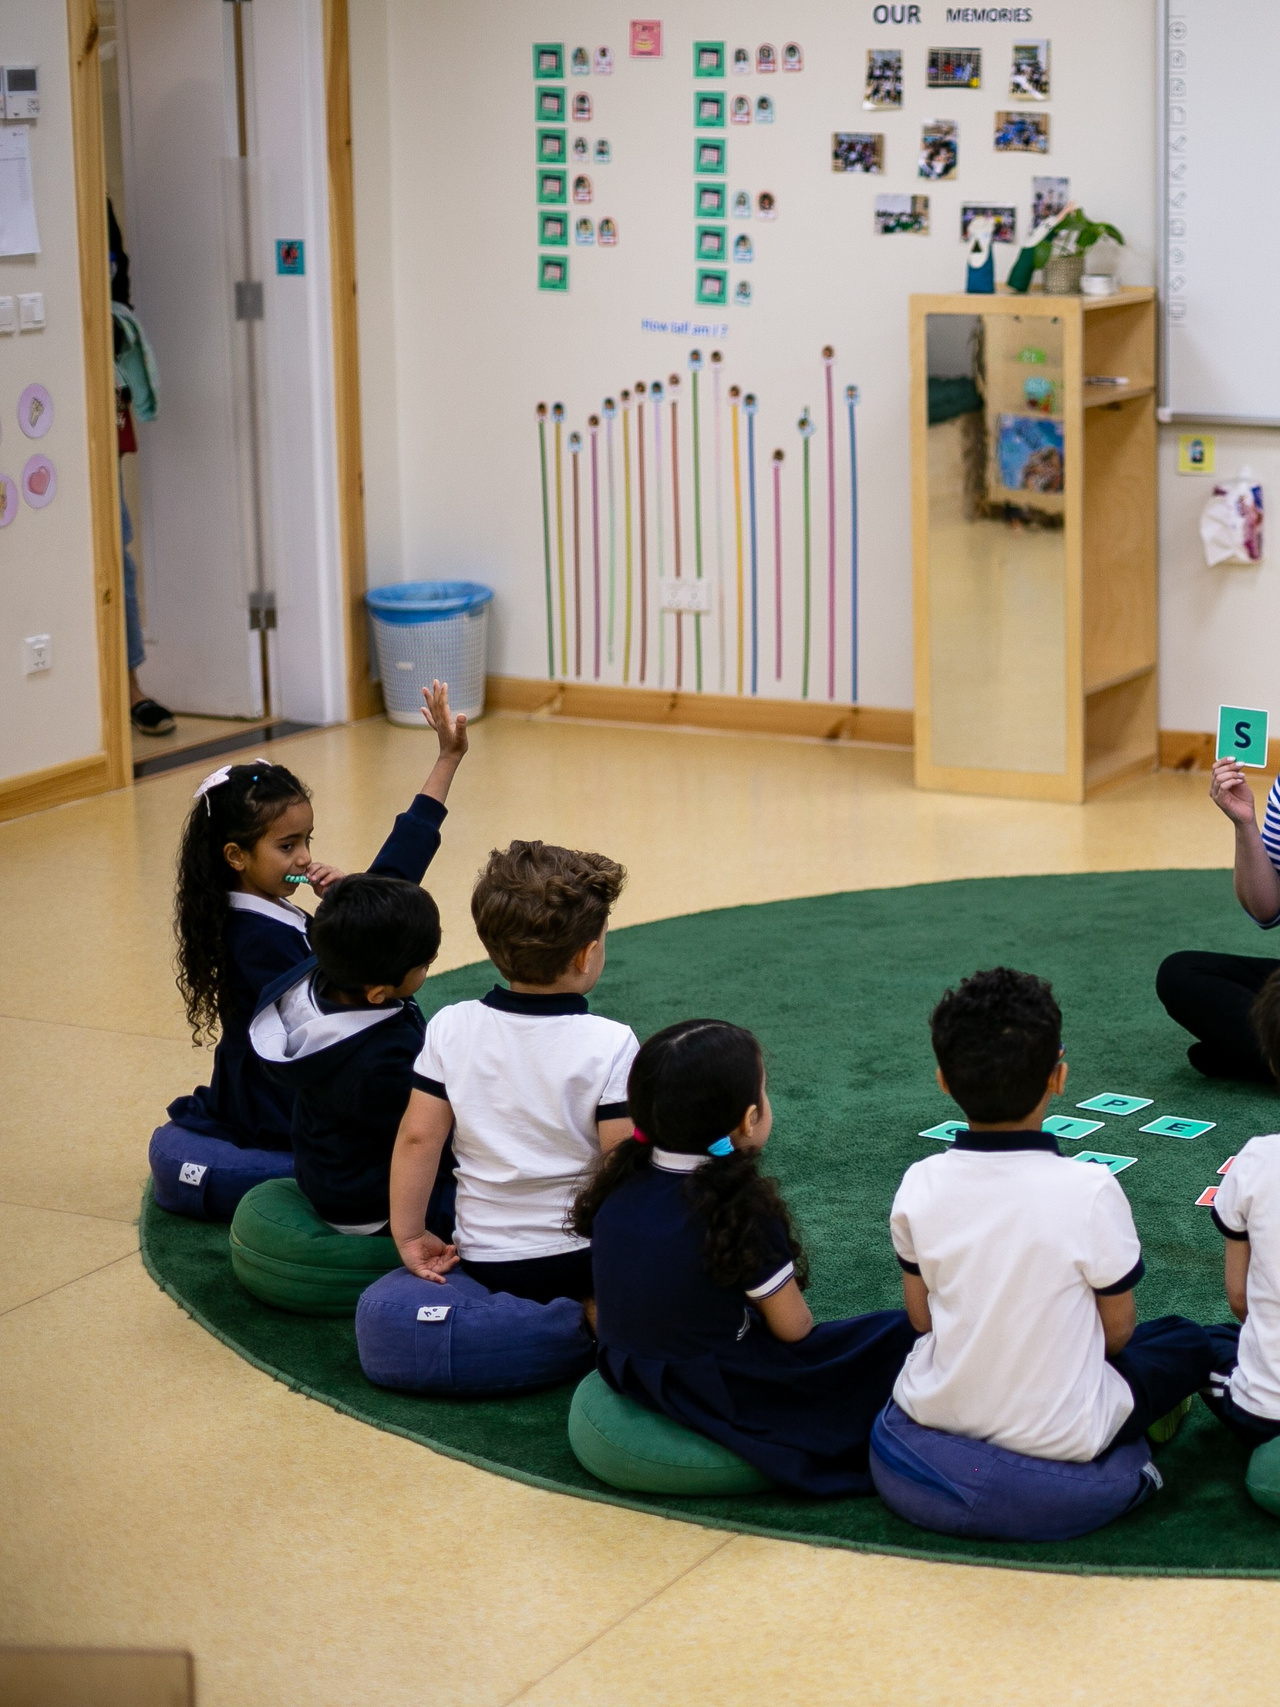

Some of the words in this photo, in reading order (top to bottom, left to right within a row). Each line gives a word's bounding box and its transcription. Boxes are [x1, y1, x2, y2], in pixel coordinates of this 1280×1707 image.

[873, 4, 921, 25] OUR
[946, 8, 1033, 23] MEMORIES
[1234, 721, 1251, 749] S
[1165, 1122, 1193, 1132] E
